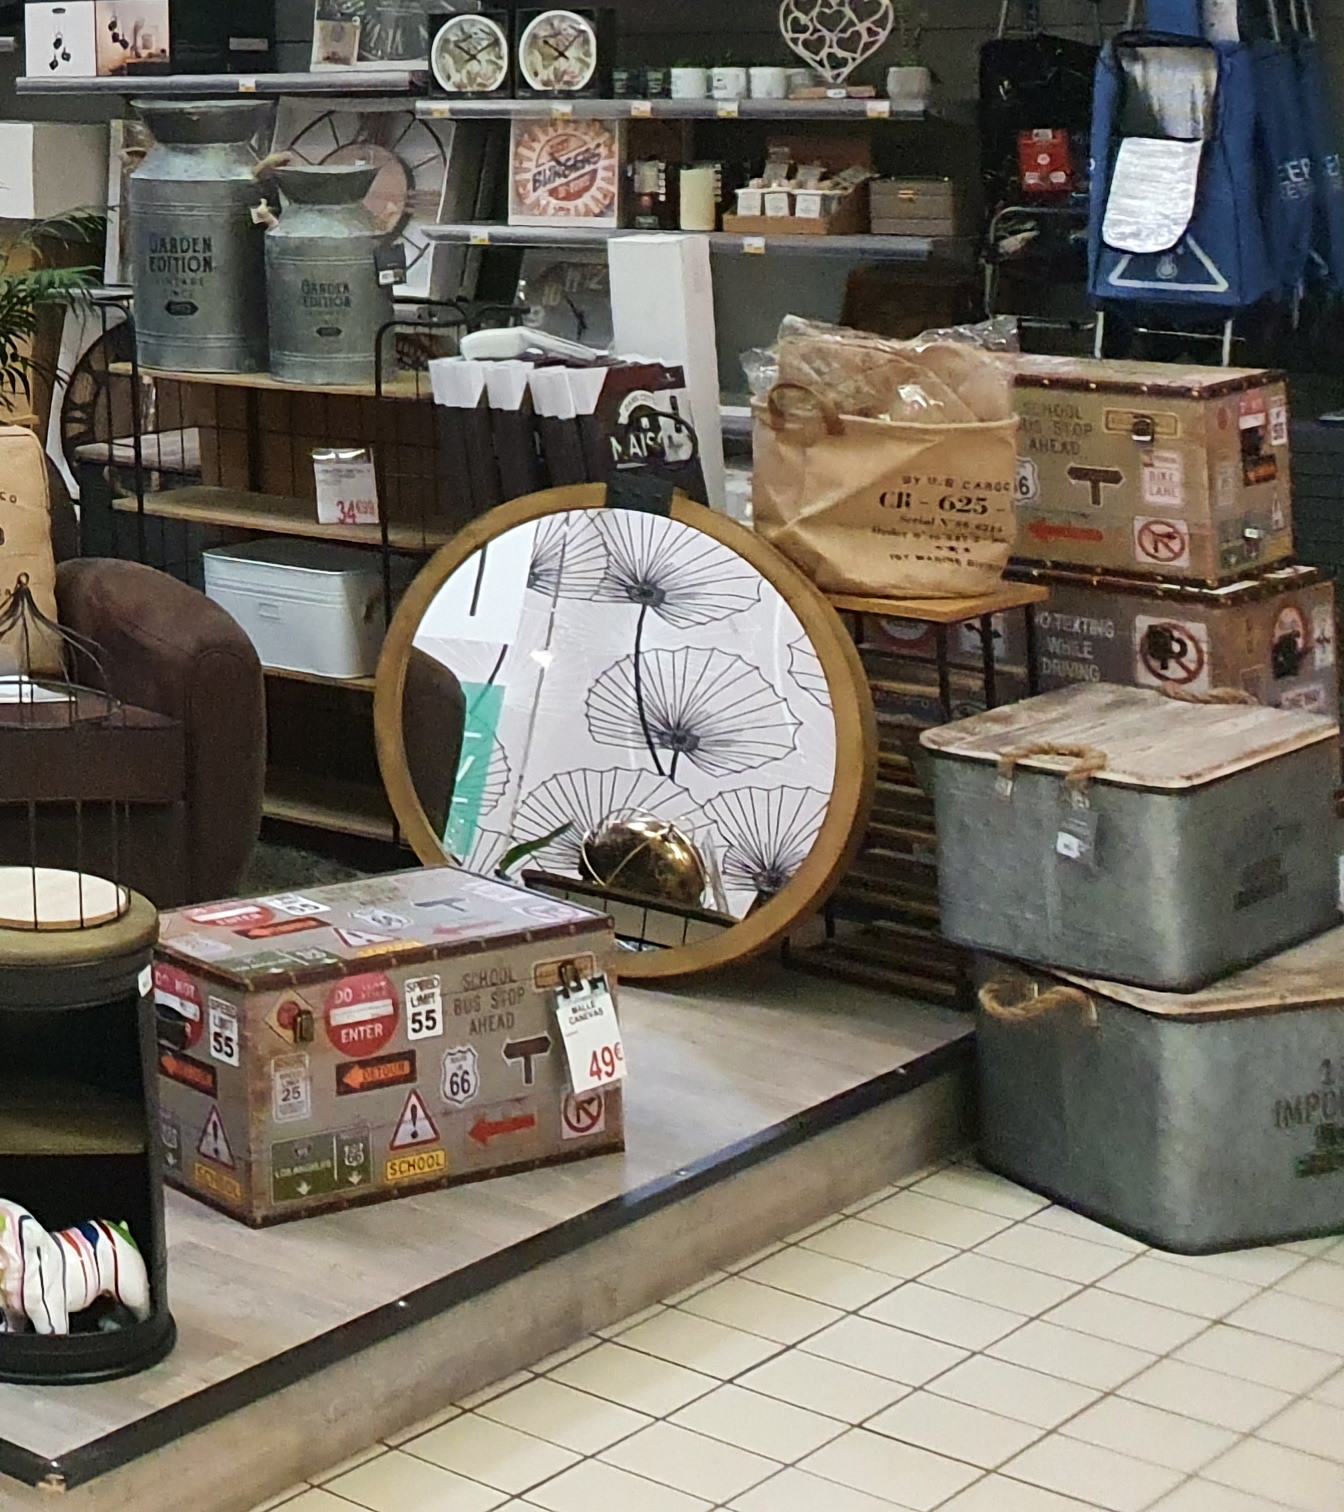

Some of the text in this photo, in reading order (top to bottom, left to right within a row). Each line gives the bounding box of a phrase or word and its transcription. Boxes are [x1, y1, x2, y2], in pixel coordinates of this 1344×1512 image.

[149, 234, 212, 254] GARDEN
[149, 255, 213, 273] EDITION
[1053, 421, 1093, 438] STOP
[1028, 439, 1081, 455] AHEAD
[0, 491, 18, 504] CO
[938, 495, 989, 515] 625
[1048, 637, 1094, 659] WHILE
[1042, 658, 1101, 682] DRIVING
[462, 967, 517, 989] SCHOOL
[334, 988, 353, 1004] DO
[454, 987, 525, 1016] BUS STOP
[411, 1009, 437, 1034] 55
[469, 1013, 515, 1036] AHEAD
[341, 1023, 384, 1043] ENTER
[212, 1031, 235, 1058] 55
[589, 1041, 624, 1081] 49€
[281, 1088, 301, 1102] 25
[449, 1071, 471, 1097] 66
[390, 1153, 444, 1176] SCHOOL
